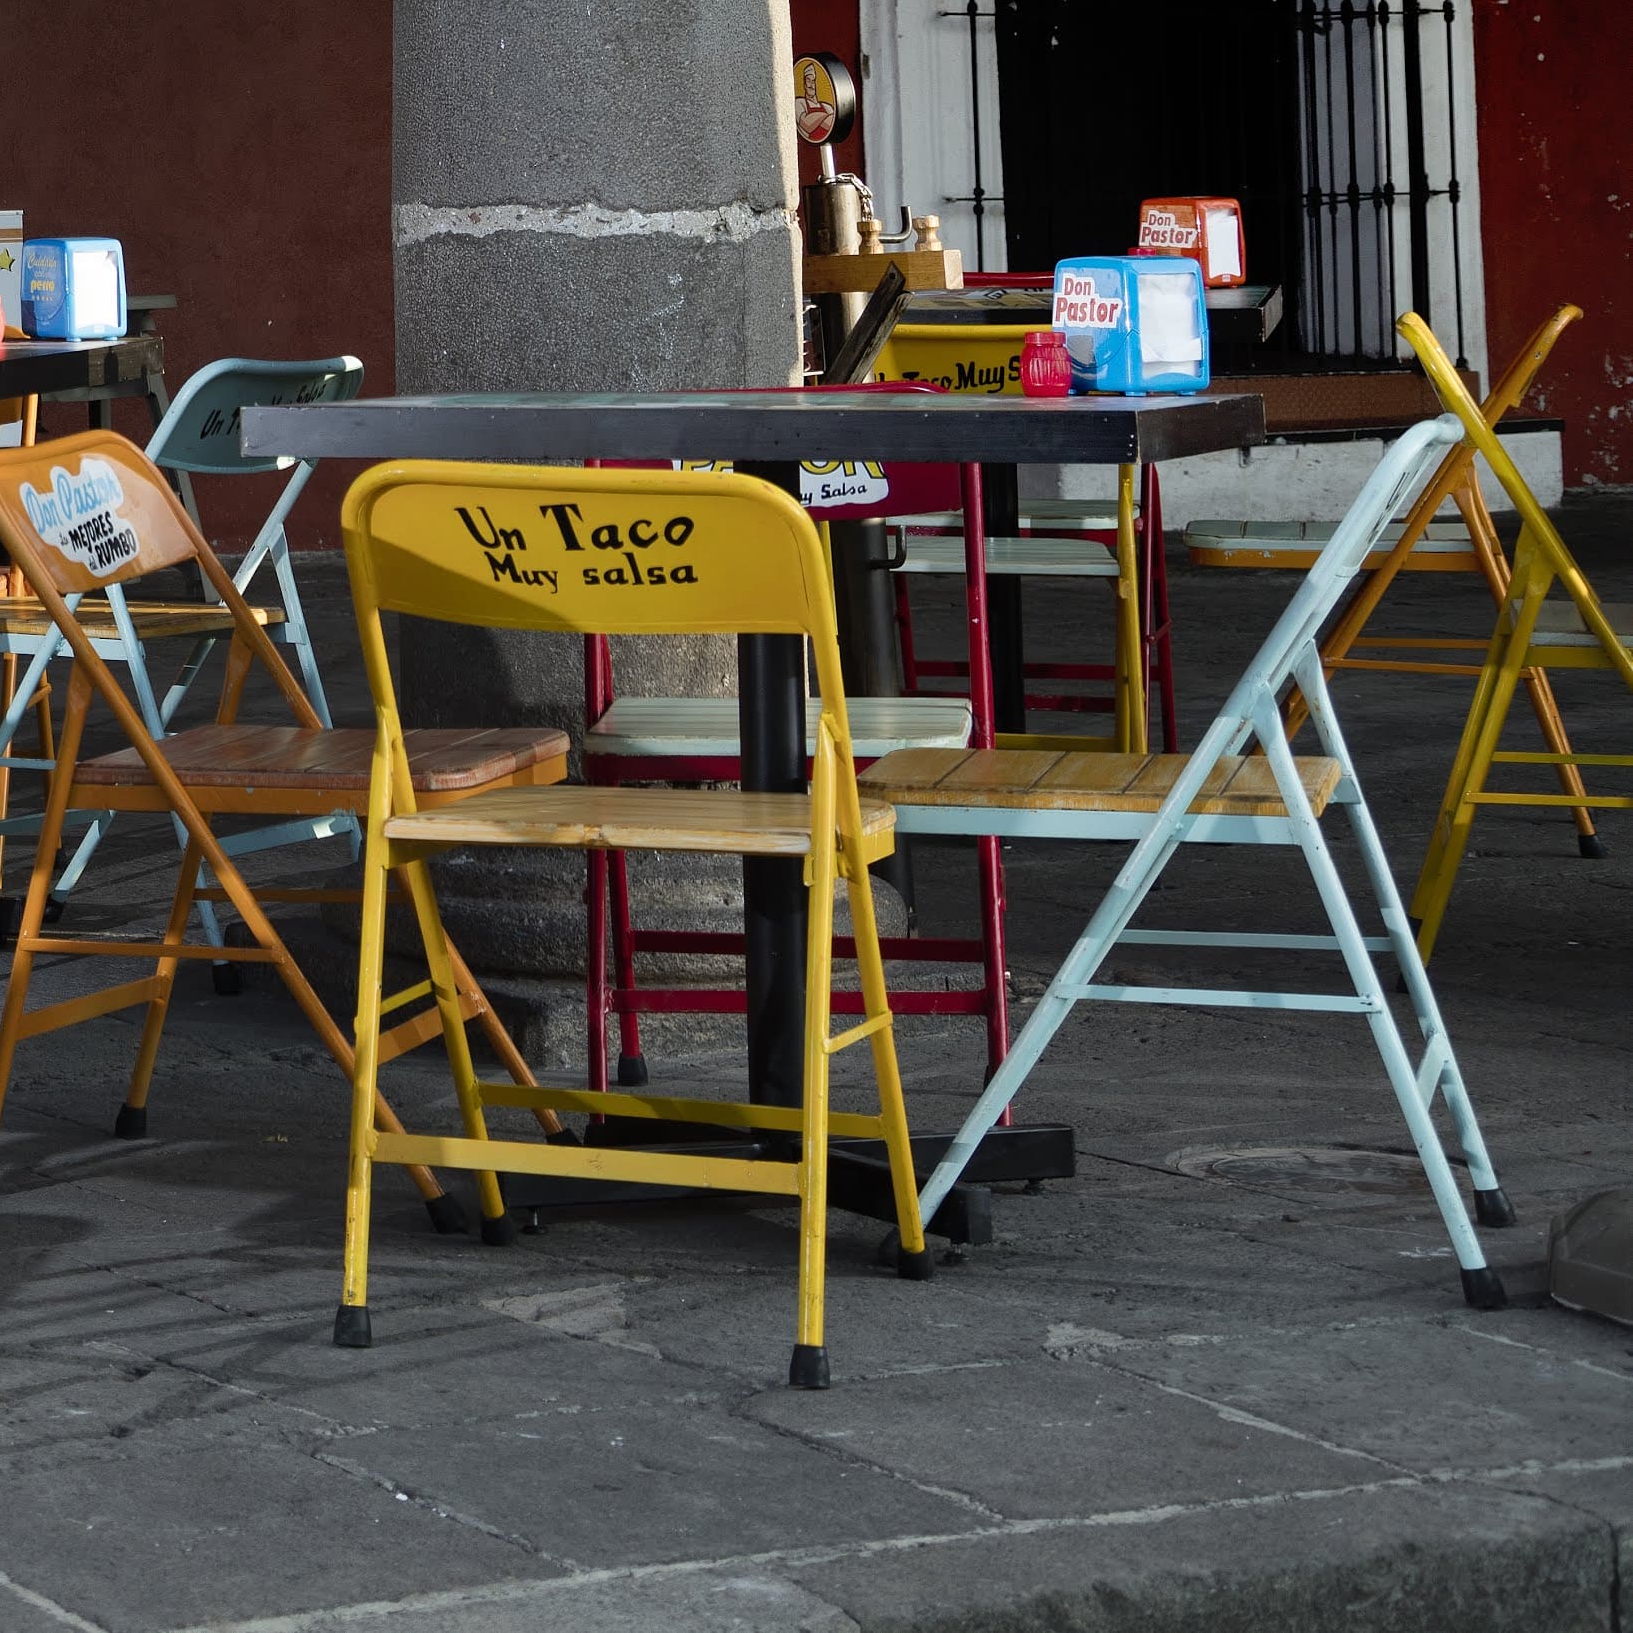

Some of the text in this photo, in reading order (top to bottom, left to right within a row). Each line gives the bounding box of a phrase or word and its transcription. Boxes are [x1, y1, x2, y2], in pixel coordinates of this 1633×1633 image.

[1141, 226, 1194, 245] Pastor
[1149, 213, 1171, 227] Don
[1064, 277, 1092, 297] Don
[1055, 297, 1119, 324] Pastor
[955, 361, 1004, 394] Muy
[200, 409, 224, 440] Un
[821, 482, 867, 500] Salsa
[26, 486, 63, 535] Don
[68, 511, 114, 554] MEJORES
[454, 503, 695, 552] Un Taco
[95, 528, 137, 569] RUMBO
[484, 551, 699, 594] Muy salsa
